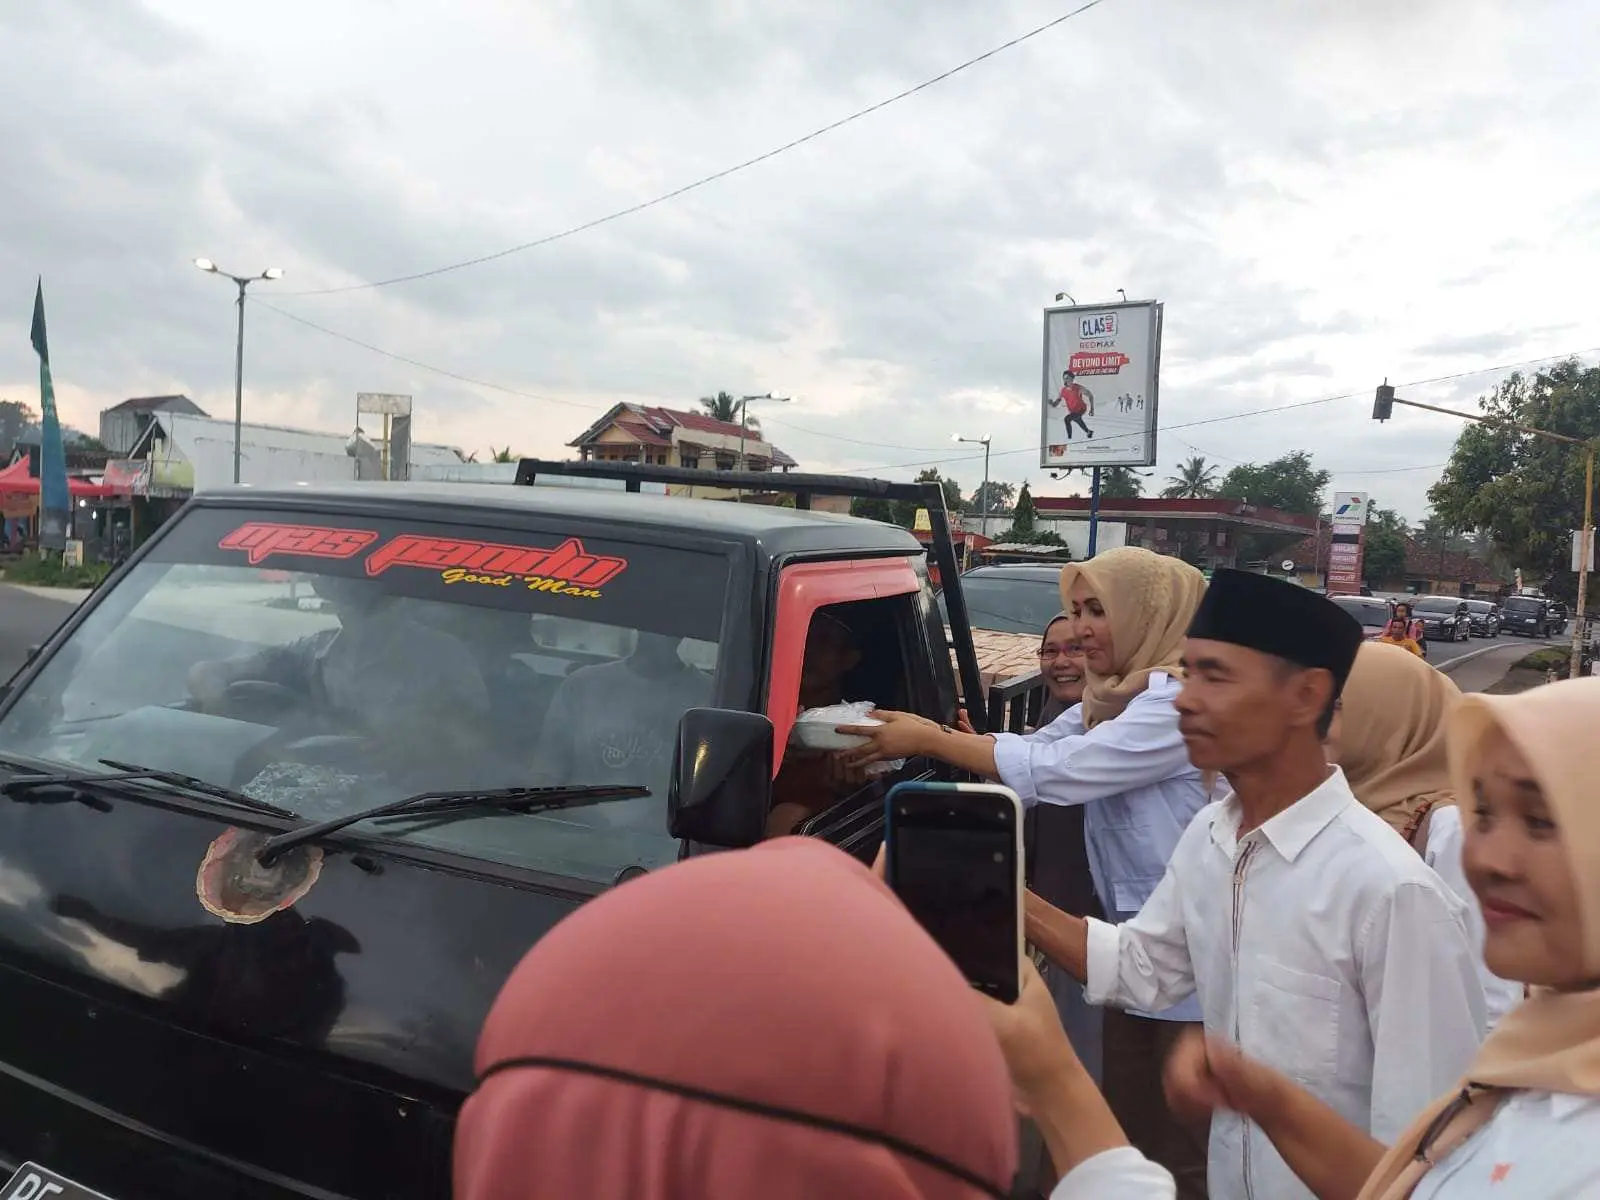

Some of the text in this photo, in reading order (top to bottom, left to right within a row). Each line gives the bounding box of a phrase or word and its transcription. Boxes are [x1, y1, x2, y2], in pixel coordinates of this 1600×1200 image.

[1072, 356, 1121, 368] BEYOND LIMIT
[440, 567, 603, 599] Good Man
